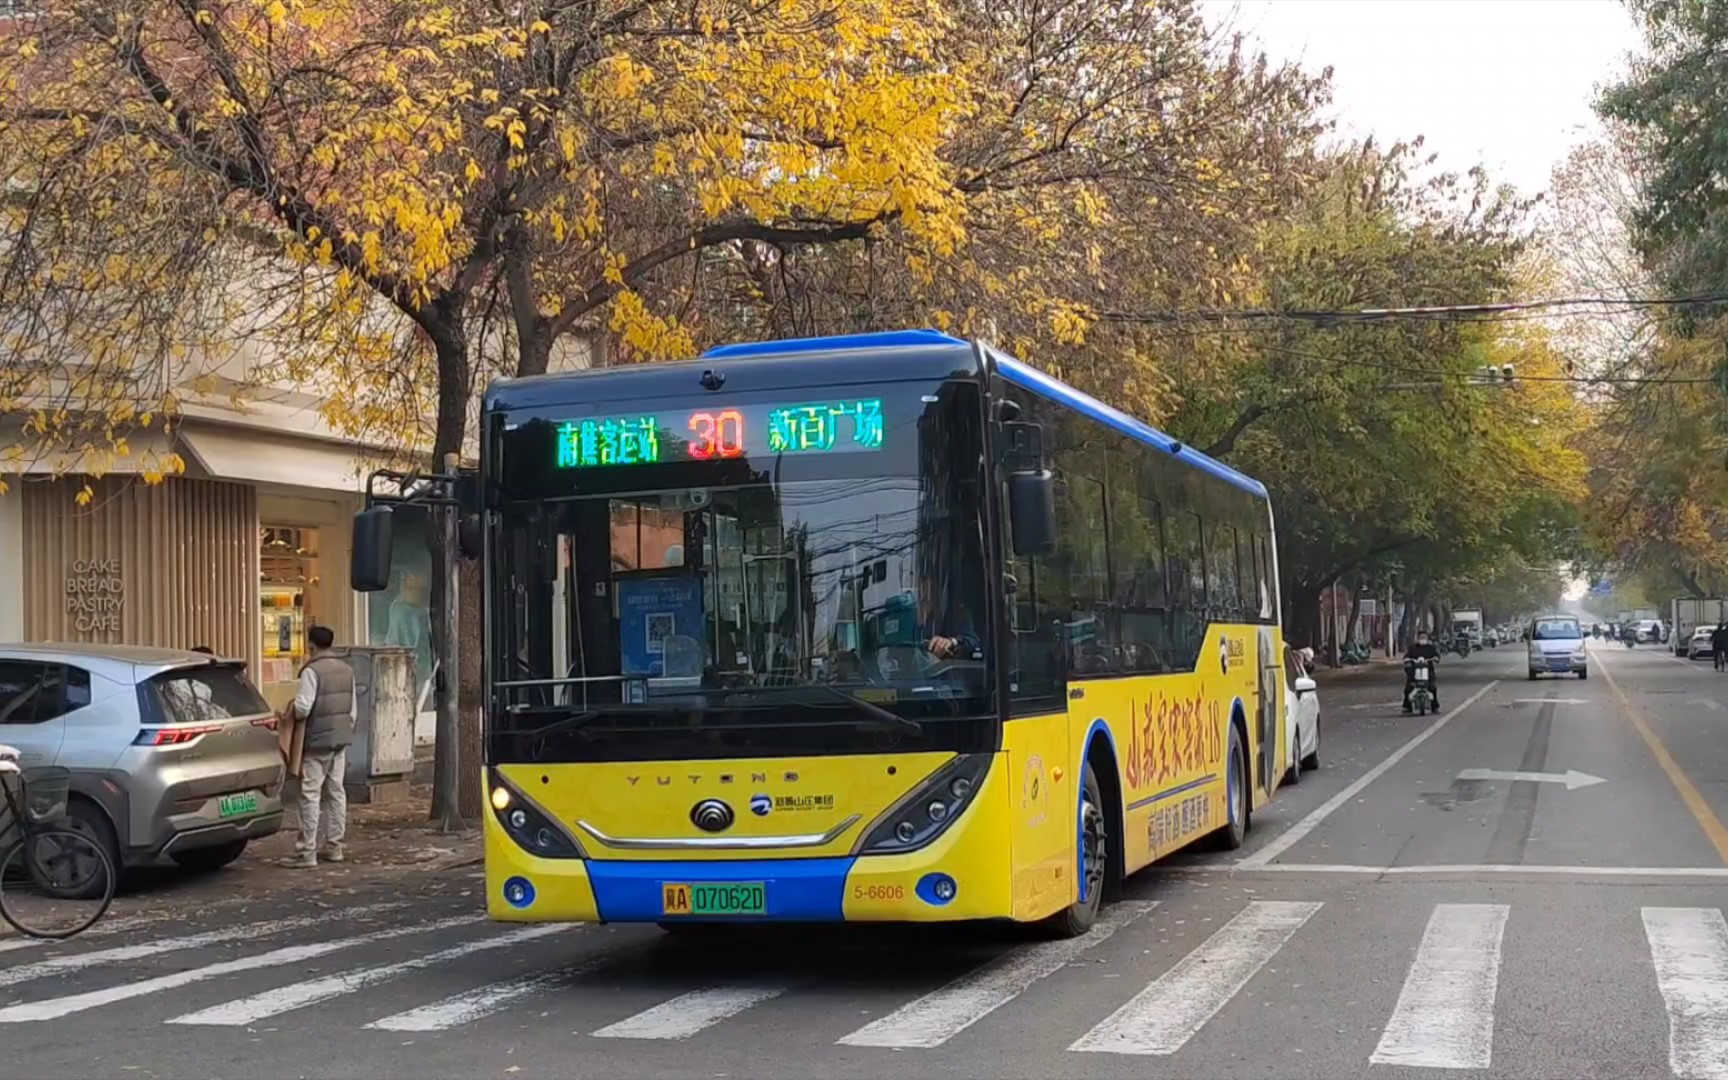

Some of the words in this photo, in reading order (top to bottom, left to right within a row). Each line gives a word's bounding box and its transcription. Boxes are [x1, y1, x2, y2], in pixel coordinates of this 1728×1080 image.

[557, 416, 659, 468] 南焦客运站
[687, 409, 743, 458] 30
[767, 398, 884, 451] 新百广场
[72, 559, 120, 573] CAKE
[66, 578, 124, 593] BREAD
[66, 597, 125, 612] PASTRY
[74, 616, 121, 631] CAFE
[854, 885, 904, 900] 5-6606
